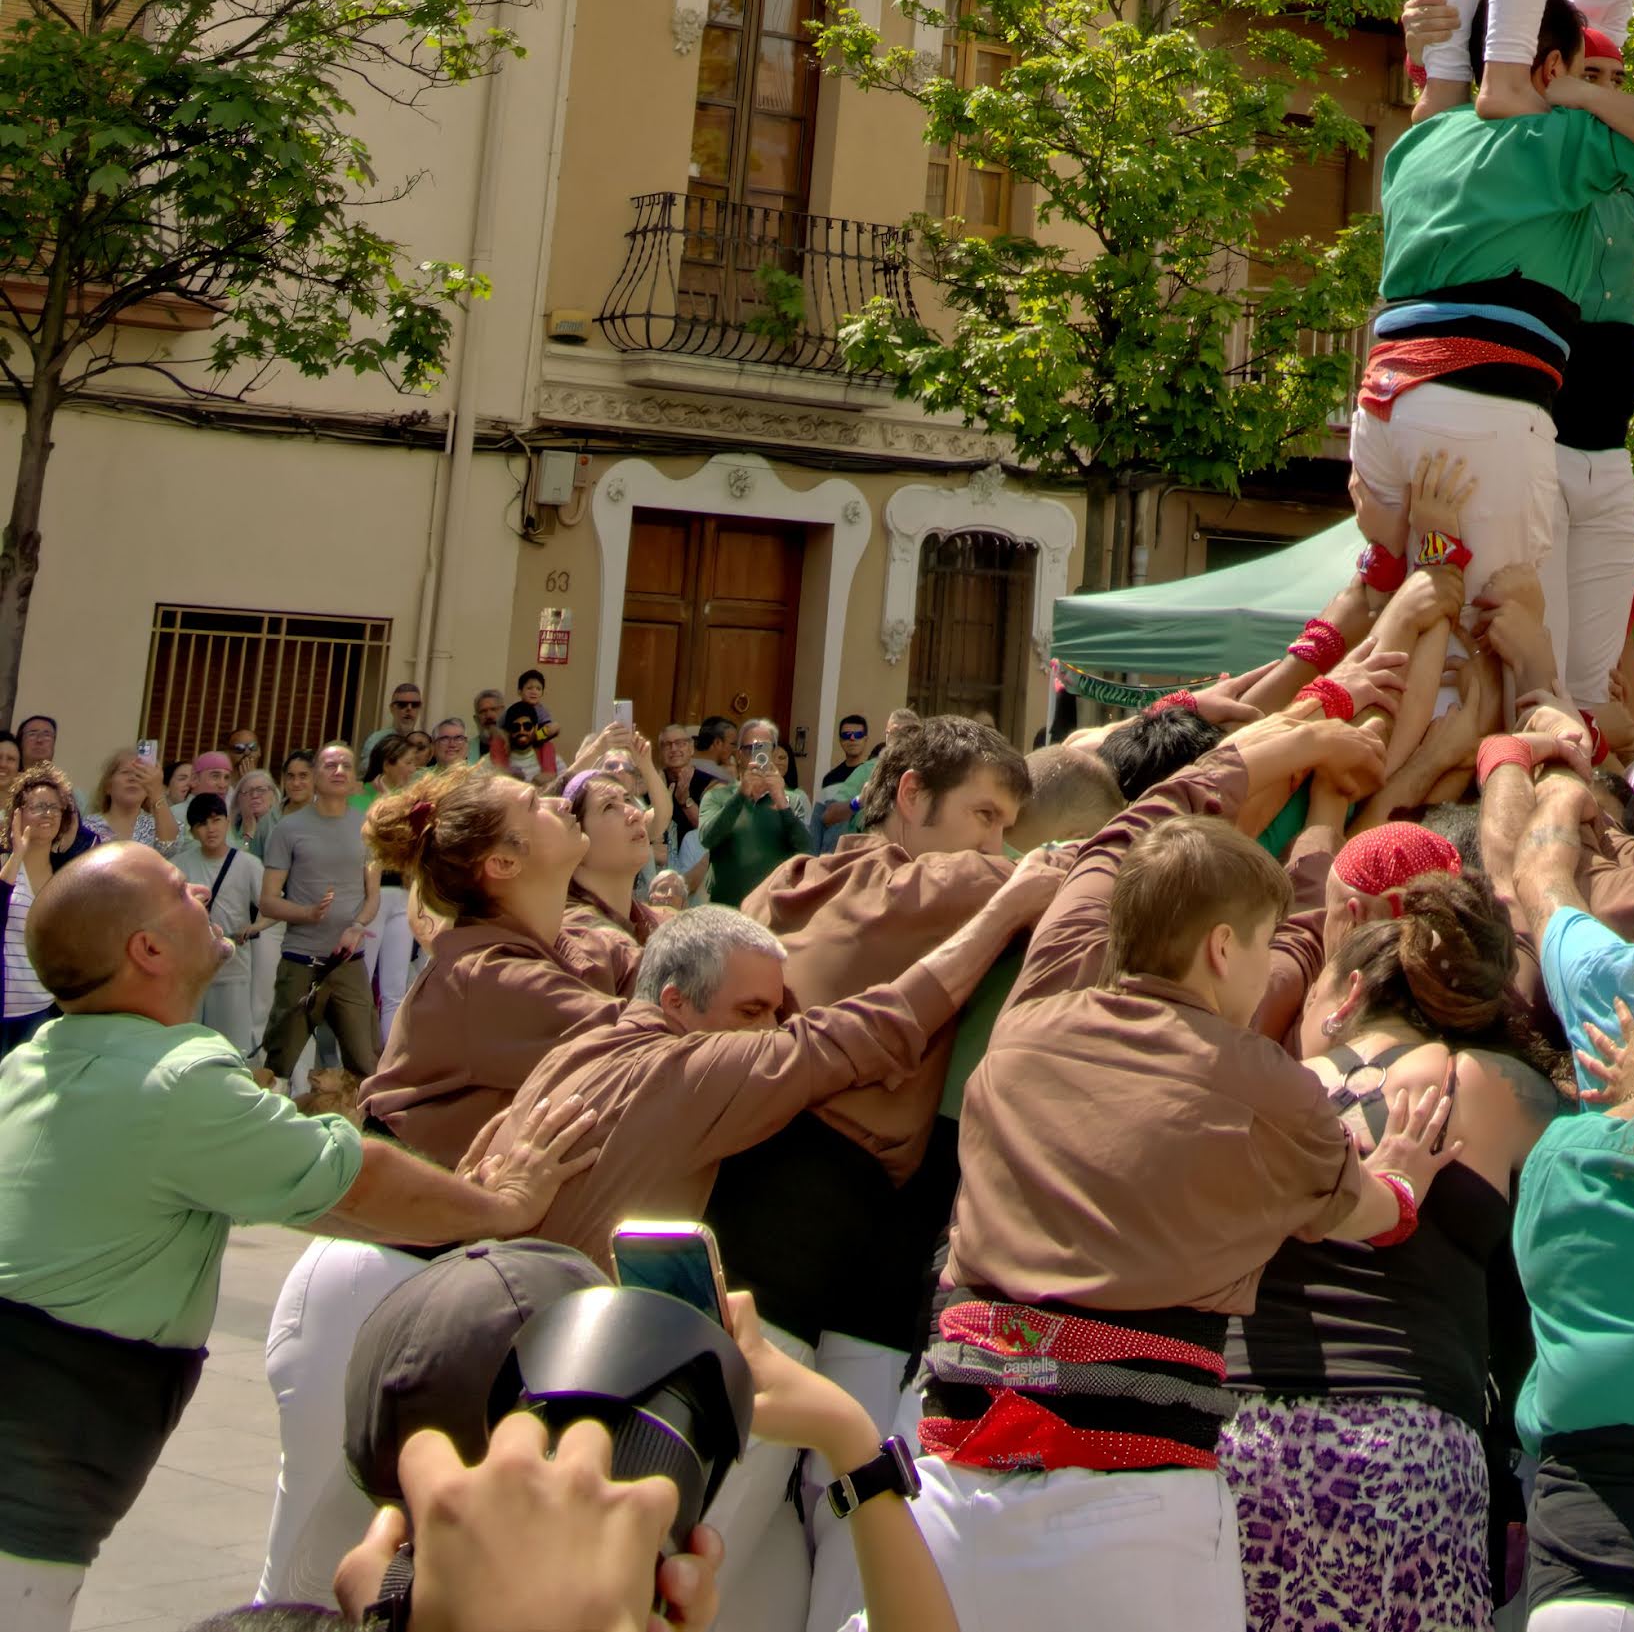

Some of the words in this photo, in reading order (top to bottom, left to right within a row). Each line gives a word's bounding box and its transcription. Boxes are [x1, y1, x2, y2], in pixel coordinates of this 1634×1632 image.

[545, 569, 570, 593] 63
[1004, 1356, 1058, 1373] castells
[1028, 1373, 1058, 1387] orgull
